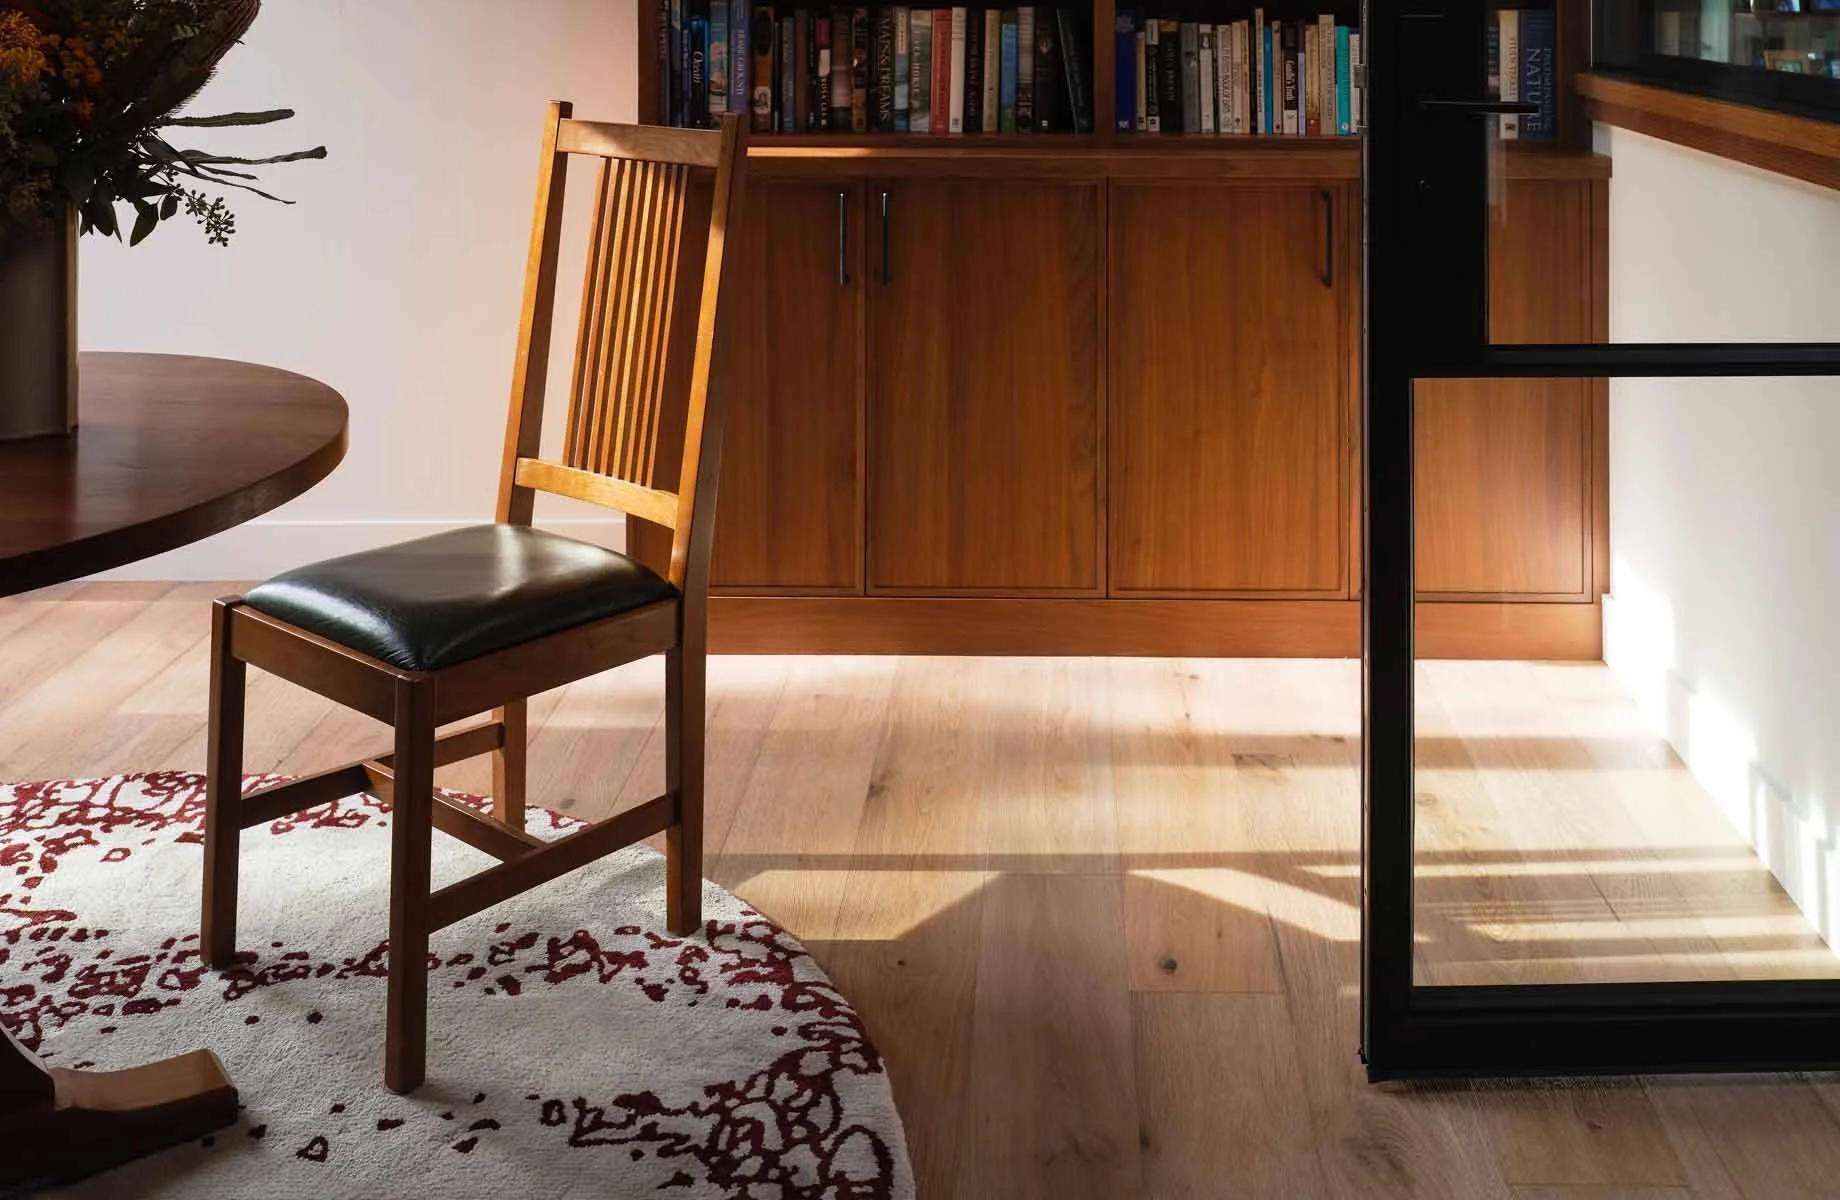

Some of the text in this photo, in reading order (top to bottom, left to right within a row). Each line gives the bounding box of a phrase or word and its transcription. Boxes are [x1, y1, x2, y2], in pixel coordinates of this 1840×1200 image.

[692, 50, 704, 84] Ocean
[736, 29, 745, 97] HOME GROUND
[879, 67, 891, 122] DREAMS
[1285, 85, 1296, 101] Truth
